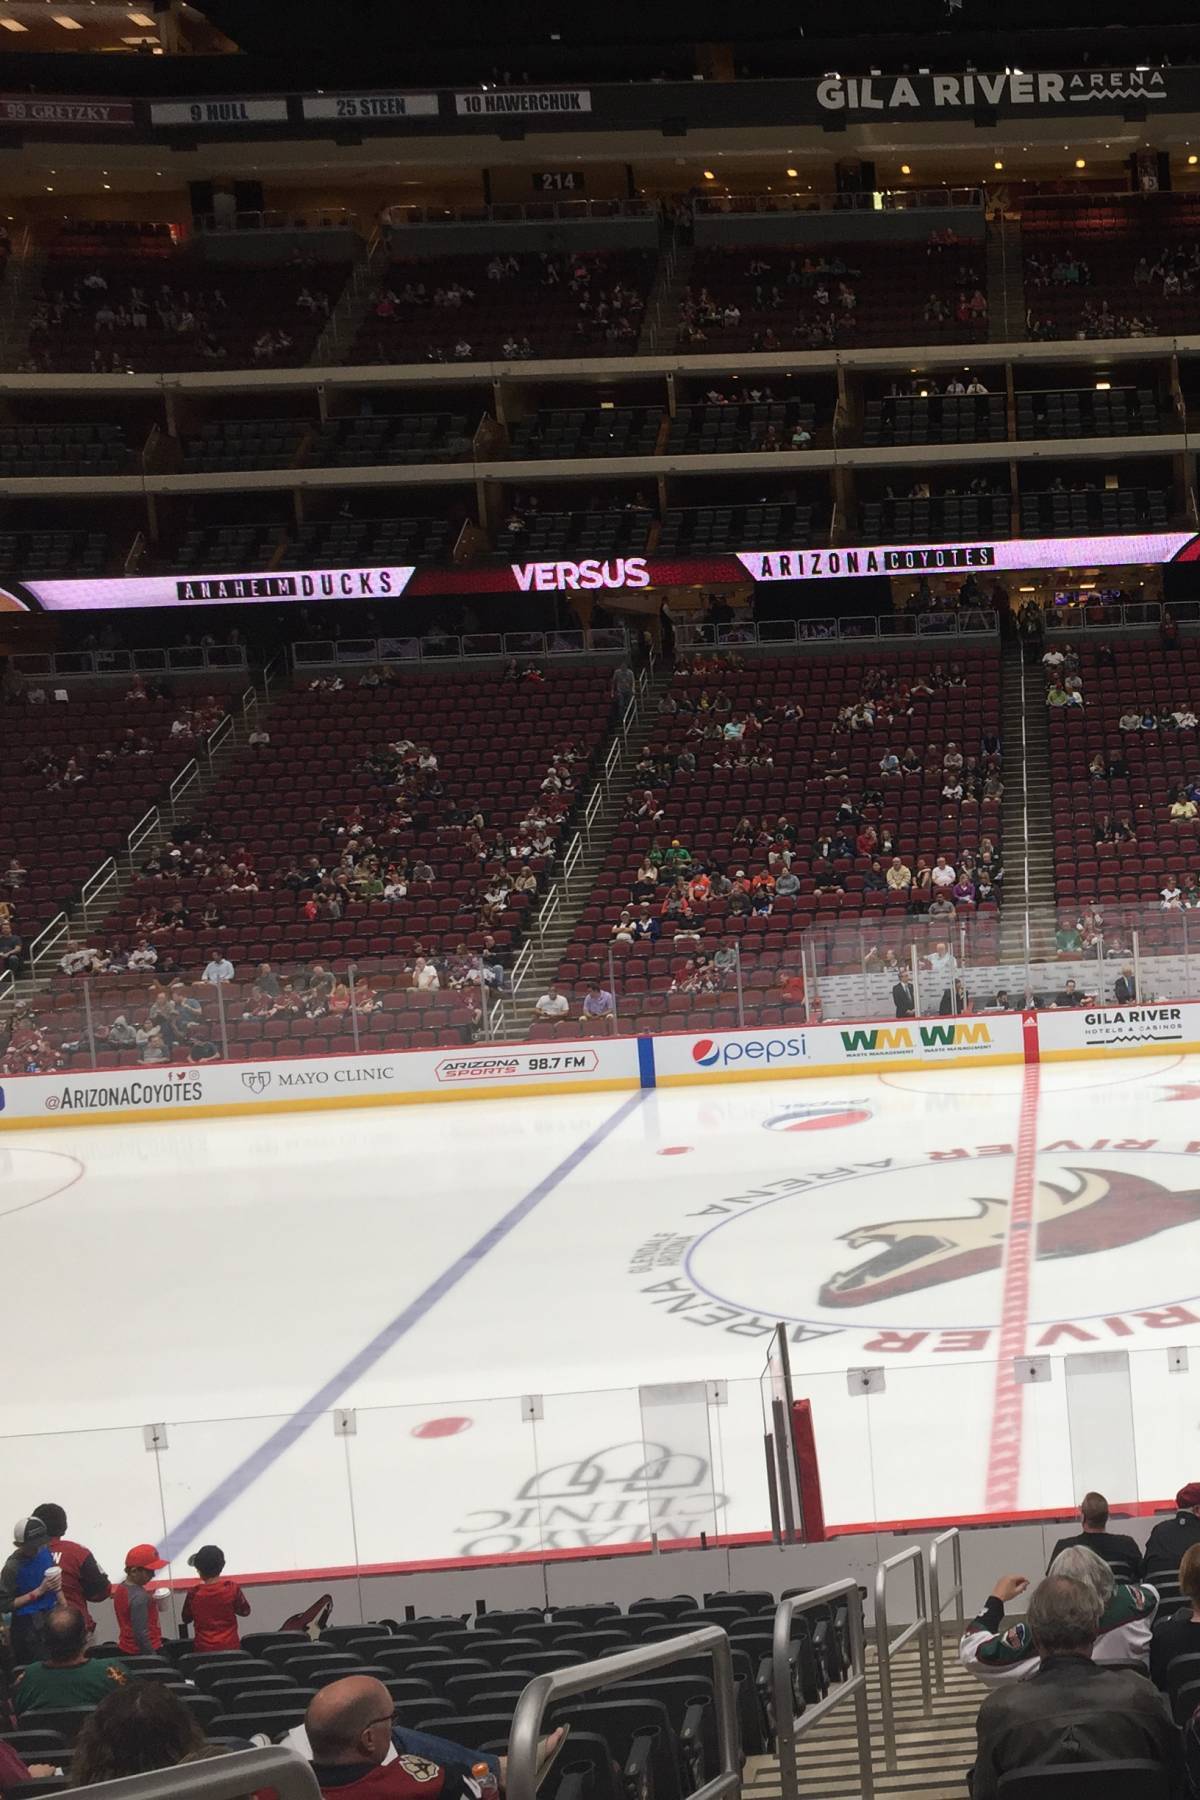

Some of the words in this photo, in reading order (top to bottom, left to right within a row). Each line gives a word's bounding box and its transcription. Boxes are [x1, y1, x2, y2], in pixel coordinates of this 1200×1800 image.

[816, 76, 920, 109] GILA
[933, 73, 1066, 107] RIVER
[1070, 72, 1165, 88] ARENA
[7, 103, 26, 119] 99
[31, 104, 110, 121] GRETZKY
[190, 104, 202, 120] 9
[206, 103, 248, 120] HULL
[336, 98, 357, 116] 25
[361, 97, 406, 115] STEEN
[464, 96, 482, 113] 10
[485, 93, 581, 113] HAWERCHUK
[542, 173, 575, 190] 214
[761, 550, 879, 577] ARIZONA
[890, 547, 991, 569] COYOTES
[184, 578, 293, 600] ANAHEIM
[303, 570, 393, 597] DUCKS
[511, 557, 651, 592] VERSUS
[1085, 1011, 1125, 1026] GILA
[1129, 1008, 1182, 1023] RIVER
[840, 1027, 913, 1051] WM
[920, 1022, 991, 1046] WM
[724, 1034, 808, 1065] pepsi
[442, 1059, 520, 1070] ARIZONA
[528, 1057, 561, 1071] 98.7
[565, 1056, 586, 1068] FM
[445, 1066, 517, 1077] SPORTS
[278, 1070, 329, 1086] MAYO
[334, 1067, 394, 1083] CLINIC
[685, 1158, 894, 1218] ARENA
[640, 1277, 848, 1343] ARENA
